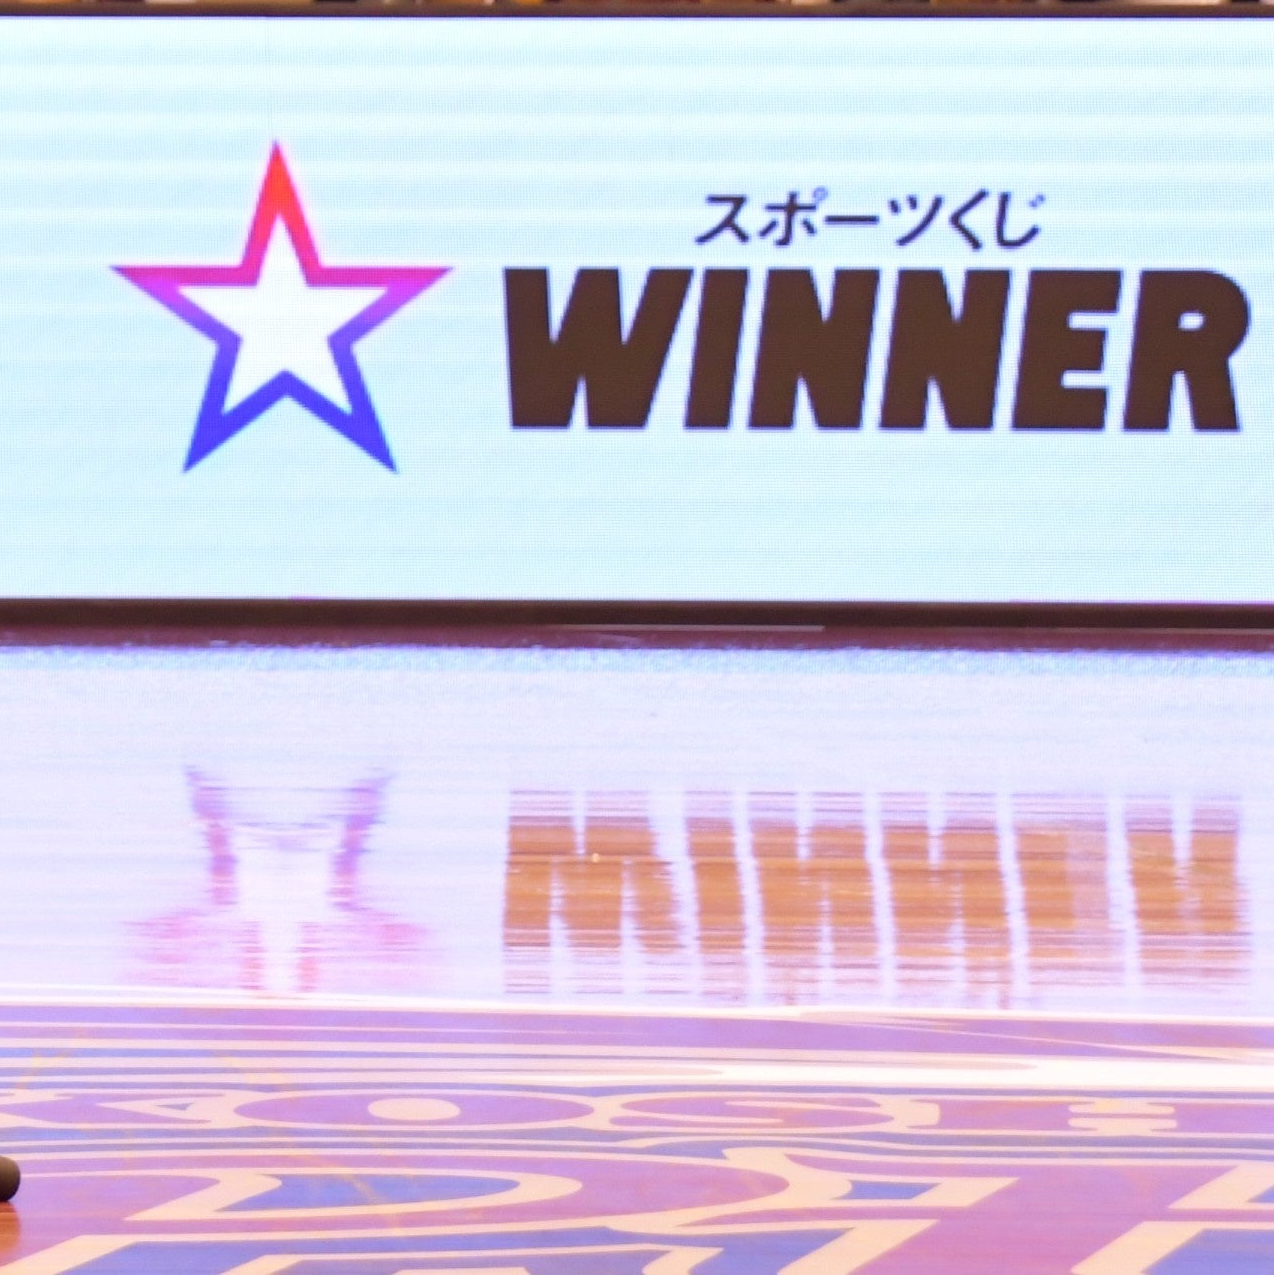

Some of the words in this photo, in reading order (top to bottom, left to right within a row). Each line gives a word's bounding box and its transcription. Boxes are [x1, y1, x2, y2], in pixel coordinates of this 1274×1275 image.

[694, 187, 1045, 250] スポーツくじ
[503, 267, 1251, 430] WINNER
